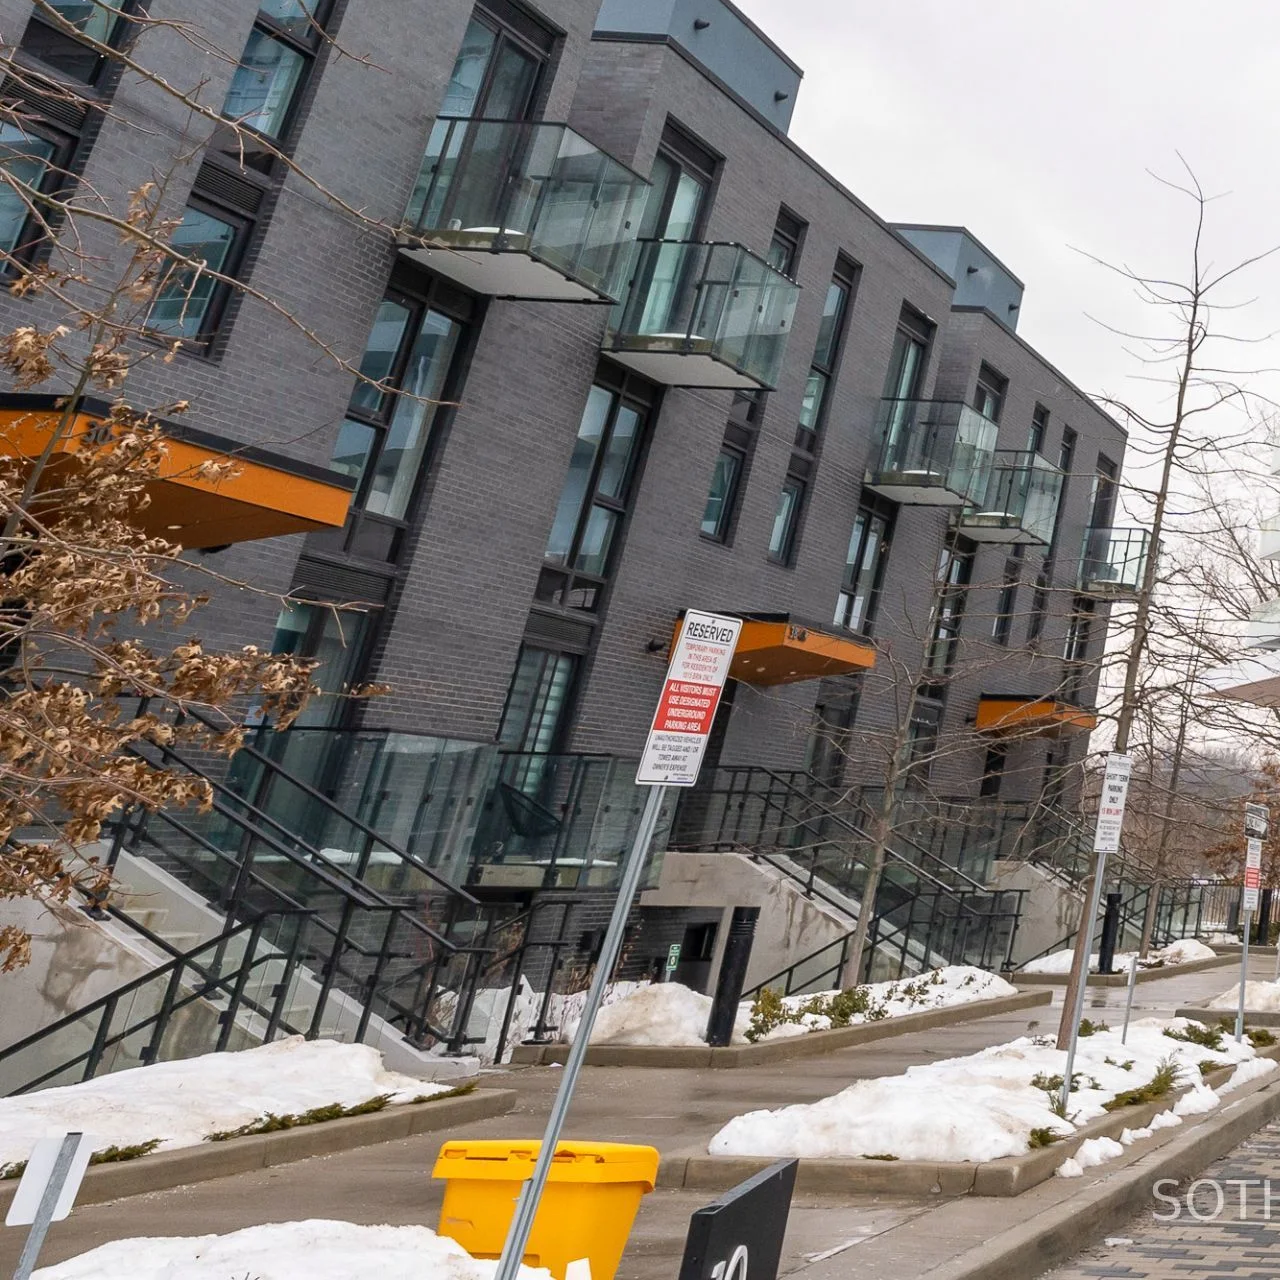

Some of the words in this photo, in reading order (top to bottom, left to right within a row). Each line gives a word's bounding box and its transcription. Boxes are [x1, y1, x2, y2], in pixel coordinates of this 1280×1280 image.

[686, 622, 734, 643] RESERVED
[669, 682, 680, 692] ALL
[680, 683, 702, 695] VISITORS
[702, 687, 717, 697] MUST
[668, 695, 680, 705] USE
[679, 696, 711, 709] DESIGNATED
[667, 708, 706, 720] UNDERGROUND
[664, 719, 687, 730] PARKING
[687, 722, 702, 731] AREA
